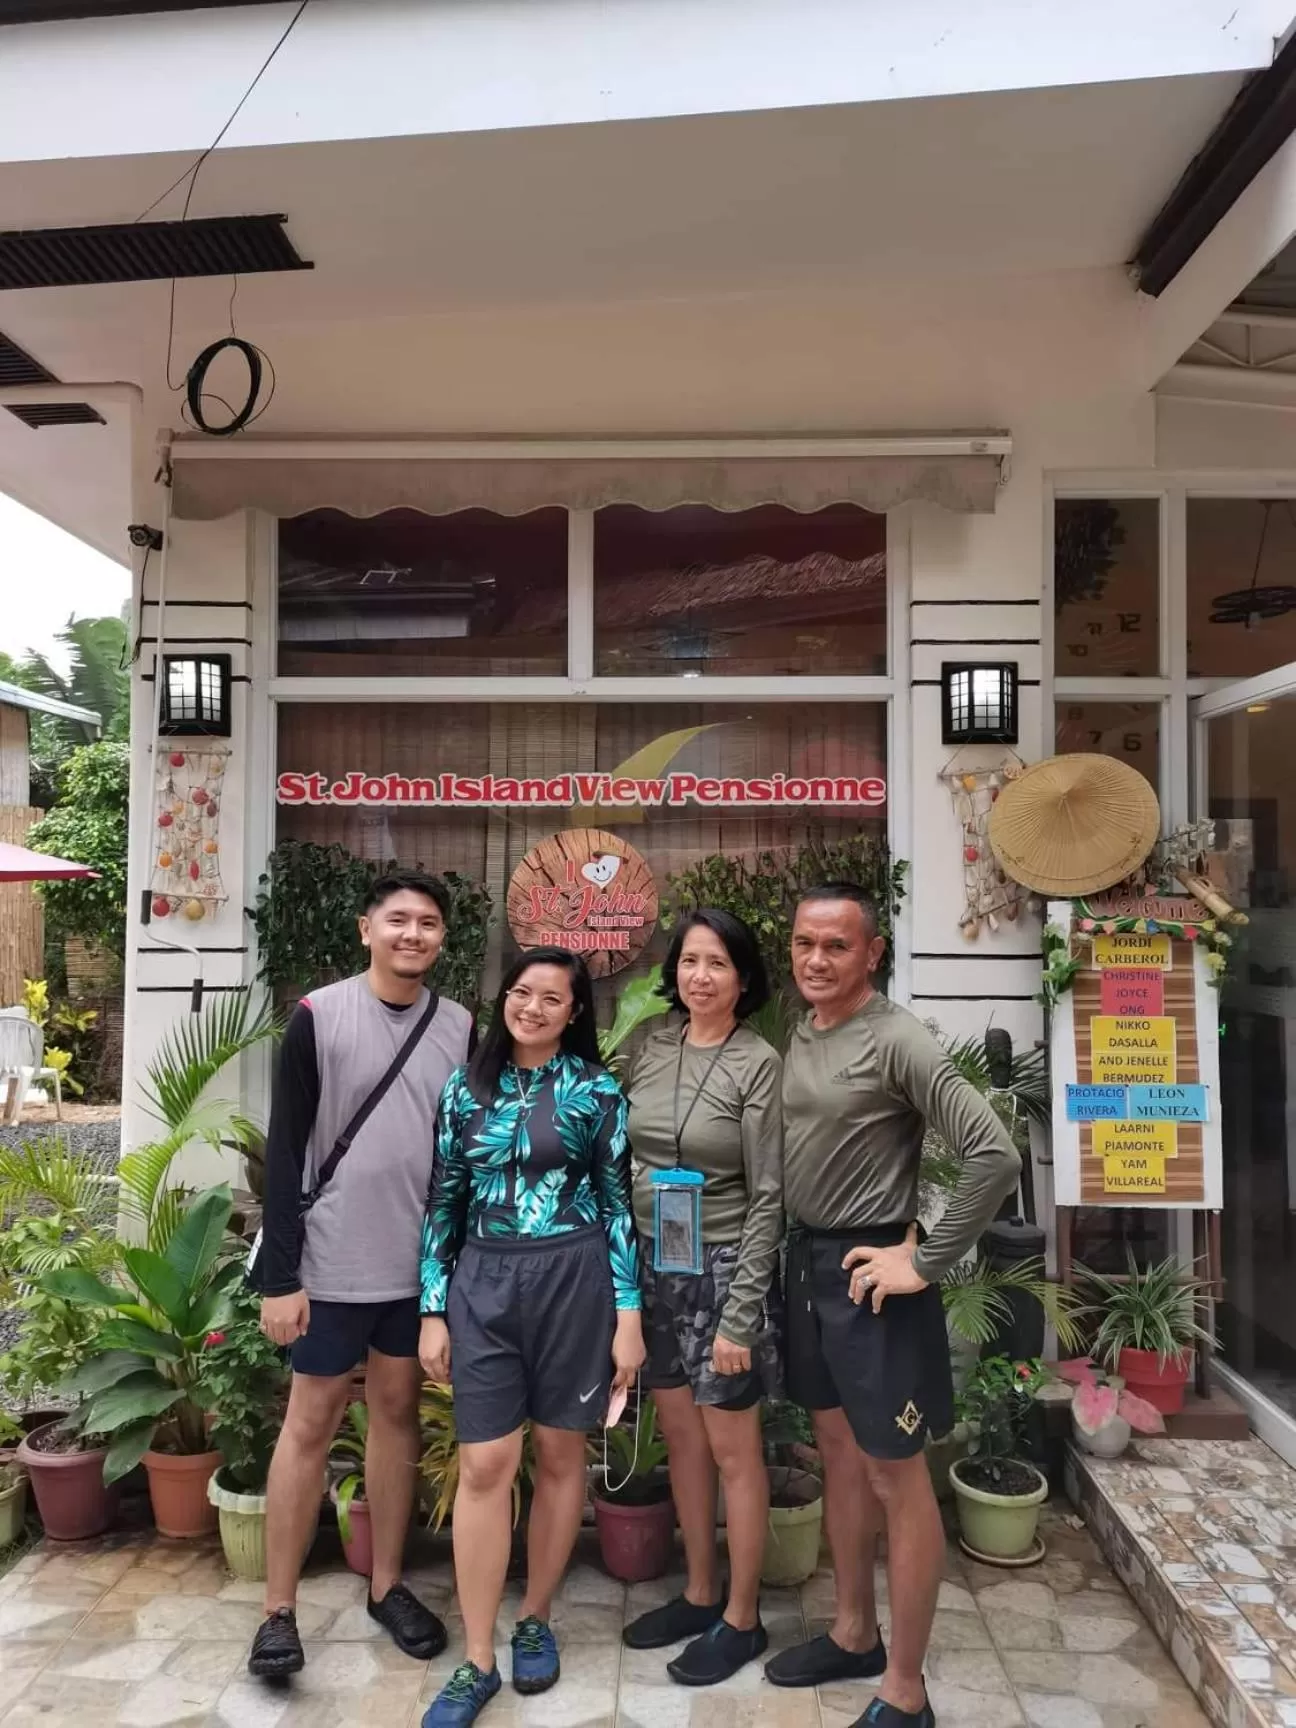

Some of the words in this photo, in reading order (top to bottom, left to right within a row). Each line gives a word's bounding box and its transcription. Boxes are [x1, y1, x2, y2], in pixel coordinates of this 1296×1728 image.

[1115, 612, 1142, 633] 12
[1088, 730, 1103, 745] 7
[1123, 732, 1142, 752] 6
[439, 772, 576, 807] Island
[574, 772, 669, 807] View
[668, 772, 887, 806] Pensionne
[562, 883, 646, 929] John
[540, 931, 630, 950] PENSIONNE
[1111, 936, 1153, 949] JORDI
[1095, 953, 1169, 965] CARBEROL
[1103, 971, 1161, 982] CHRISTINE
[1116, 987, 1149, 999] JOYCE
[1119, 1004, 1145, 1016] ONG
[1115, 1020, 1151, 1031] NIKKO
[1108, 1037, 1158, 1049] DASALLA
[1098, 1055, 1123, 1067] AND
[1124, 1056, 1169, 1067] JENELLE
[1103, 1073, 1165, 1084] BERMUDEZ
[1068, 1087, 1125, 1098] PROTACIO
[1149, 1088, 1186, 1100] LEON
[1077, 1105, 1118, 1116] RIVERA
[1137, 1105, 1200, 1117] MUNIEZA
[1114, 1123, 1155, 1134] LAARNI
[1104, 1140, 1165, 1152] PIAMONTE
[1121, 1158, 1148, 1170] YAM
[1105, 1175, 1164, 1187] VILLAREAL
